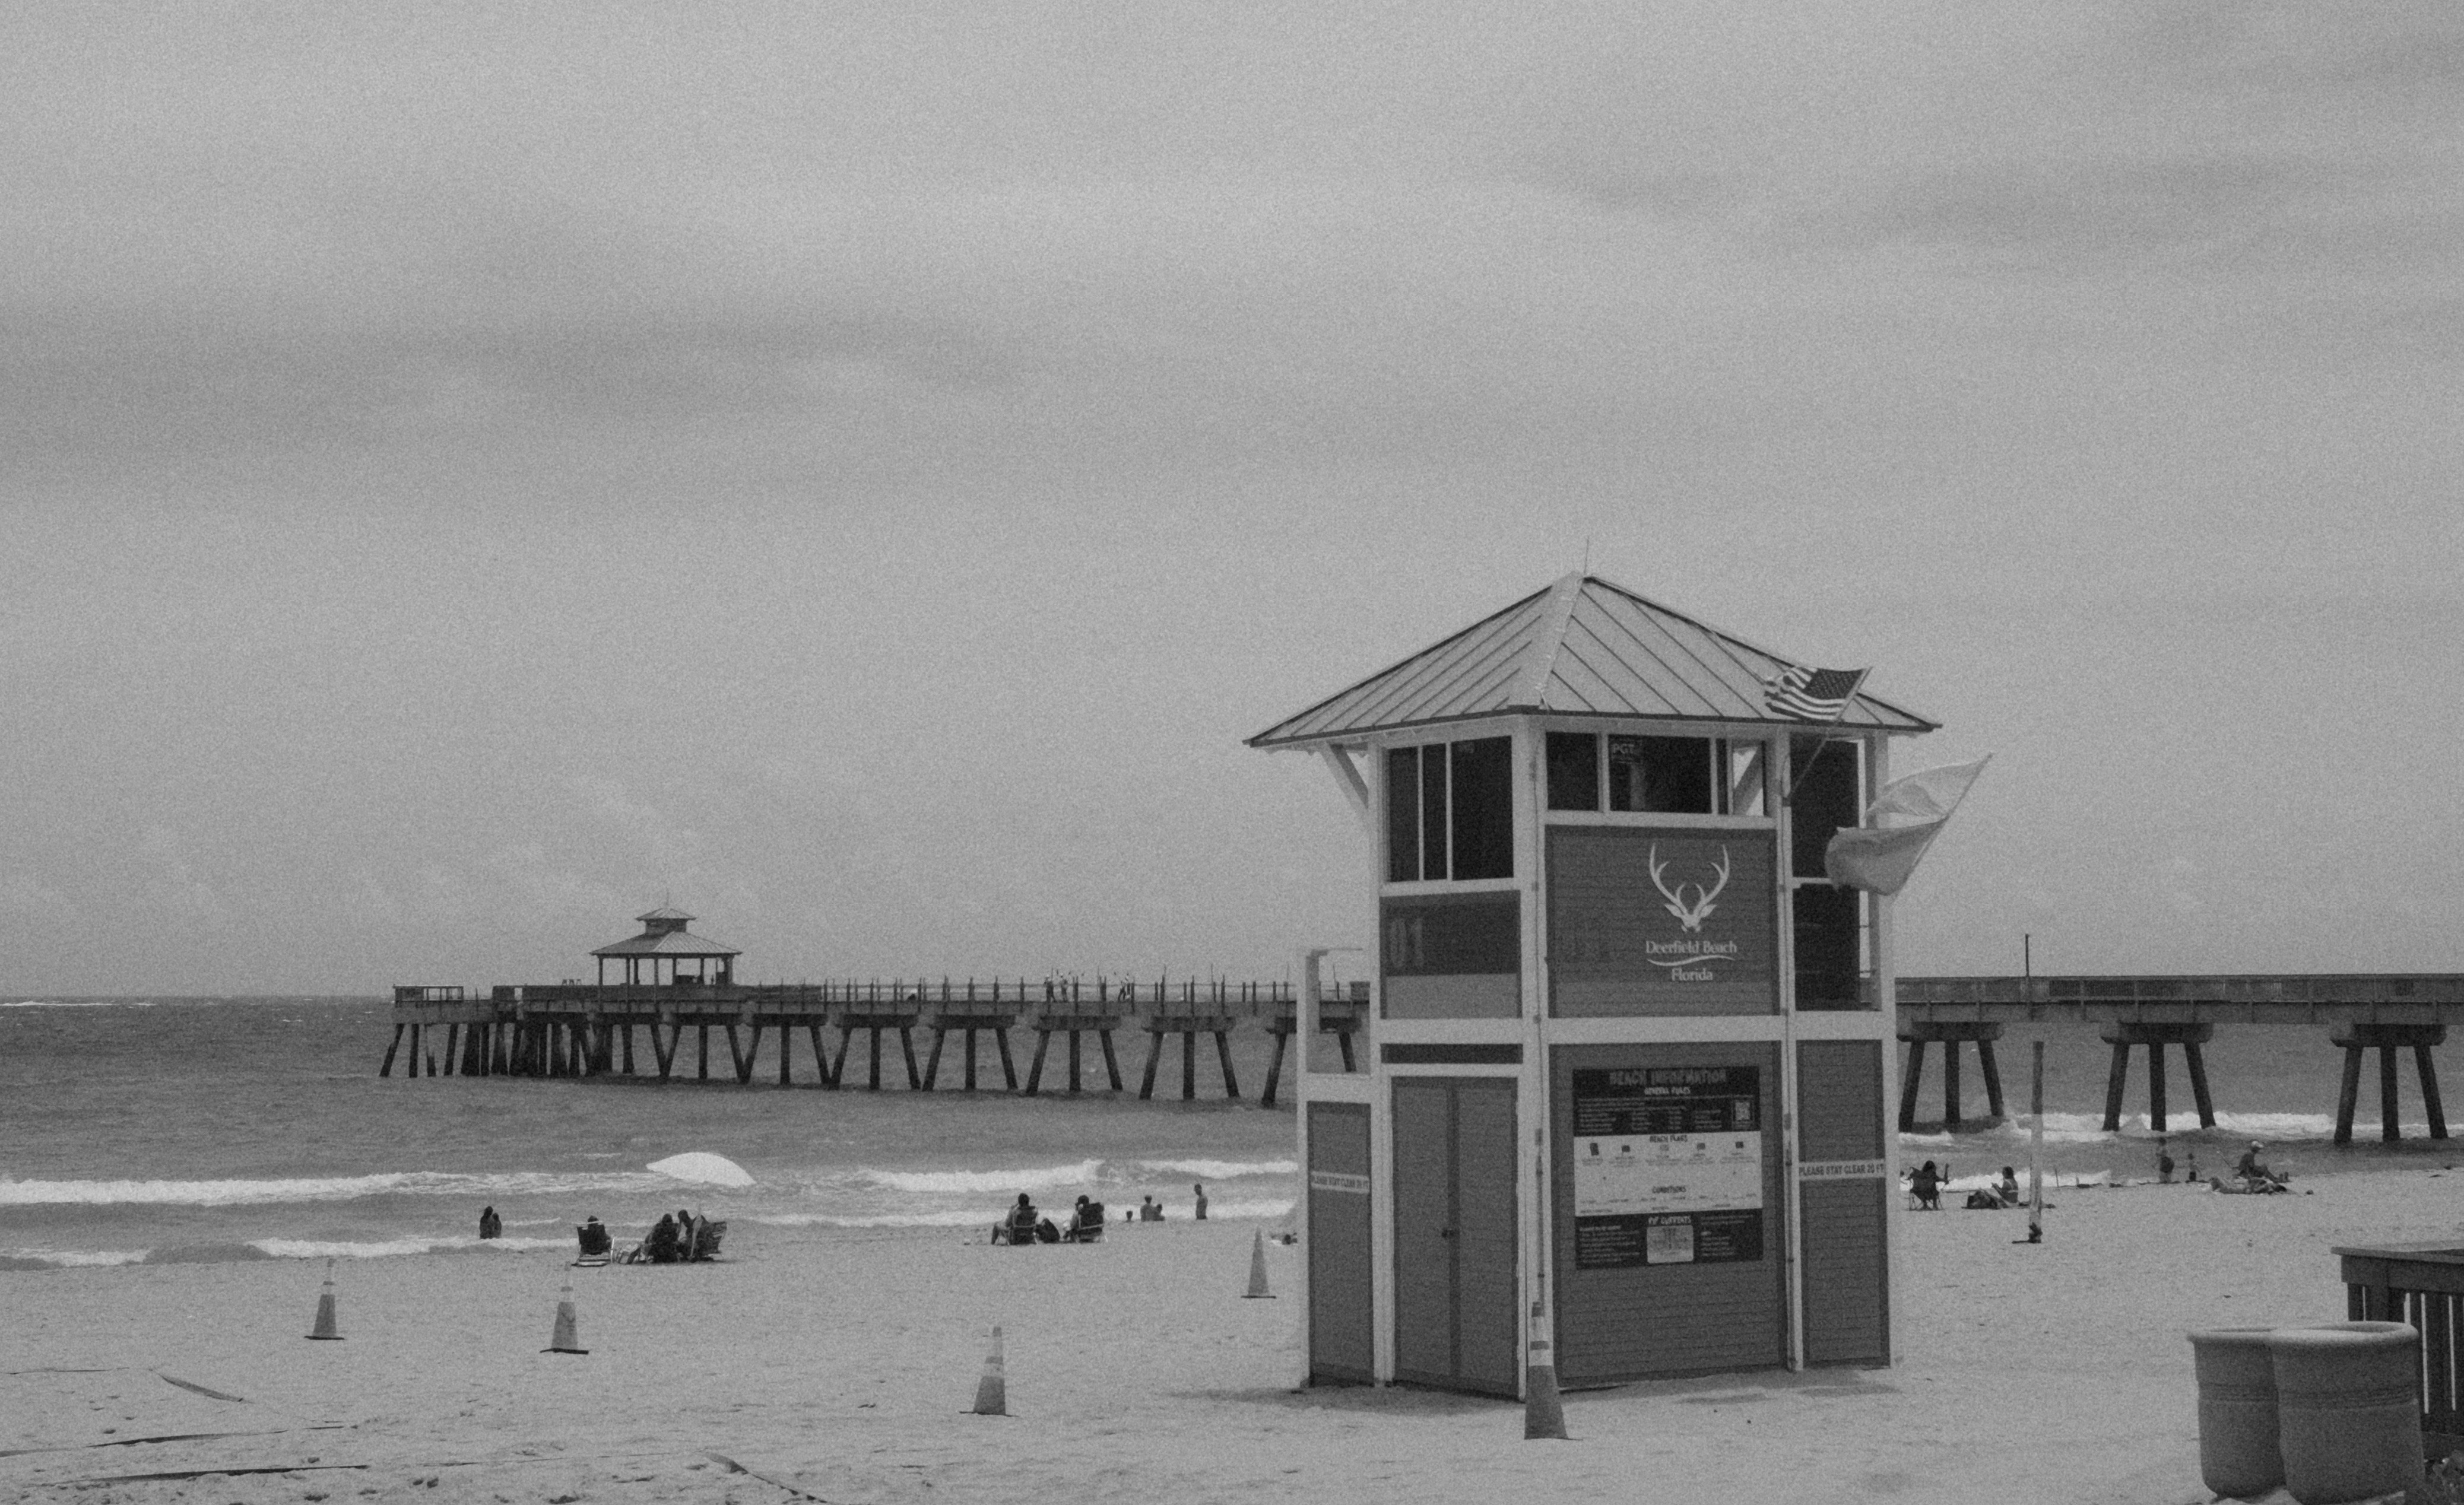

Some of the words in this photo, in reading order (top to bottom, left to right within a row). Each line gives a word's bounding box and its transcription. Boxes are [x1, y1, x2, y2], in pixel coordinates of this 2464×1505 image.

[1390, 918, 1424, 969] 01
[1645, 940, 1699, 954] Deerfield
[1702, 940, 1737, 954] Beach
[1671, 967, 1714, 981] Florida
[1609, 1070, 1647, 1085] BEACH
[1650, 1069, 1727, 1085] INFORMATION
[1799, 1166, 1824, 1176] PLEASE
[1826, 1165, 1843, 1175] STAY
[1844, 1164, 1866, 1174] CLEAR
[1876, 1163, 1884, 1173] FT
